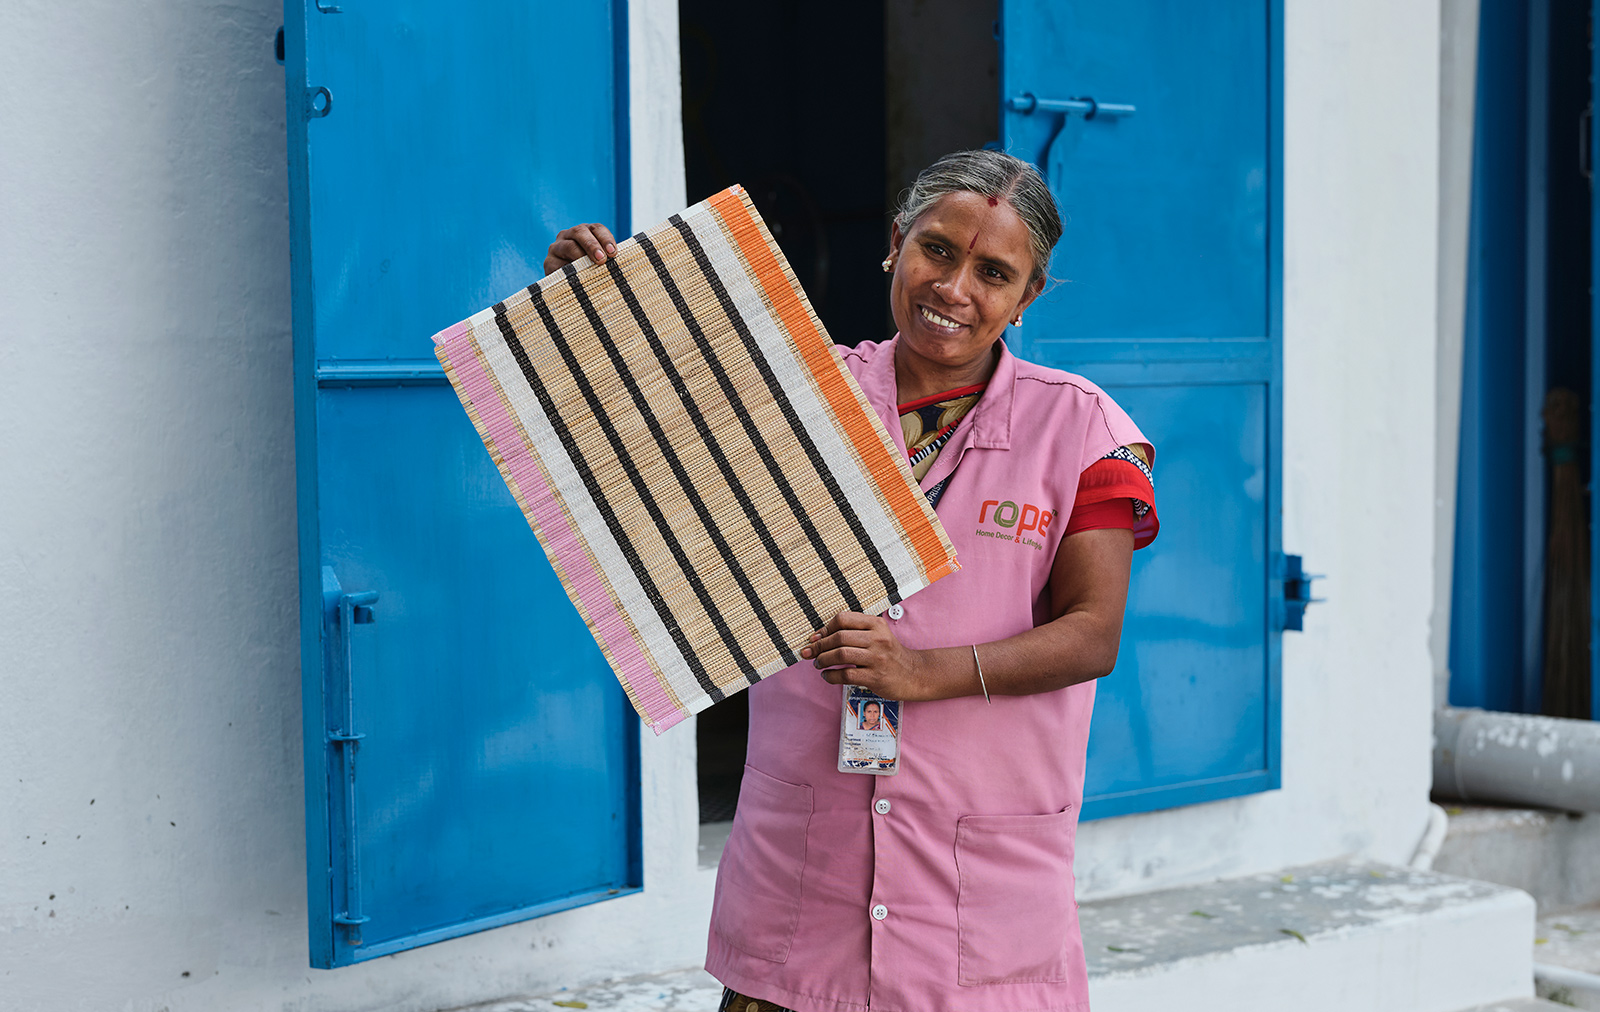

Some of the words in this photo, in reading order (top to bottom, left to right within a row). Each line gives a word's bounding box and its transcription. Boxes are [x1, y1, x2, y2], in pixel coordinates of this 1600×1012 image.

[927, 480, 946, 504] PRISE
[978, 500, 1053, 538] rope
[976, 529, 995, 538] Home
[996, 531, 1015, 541] Decor
